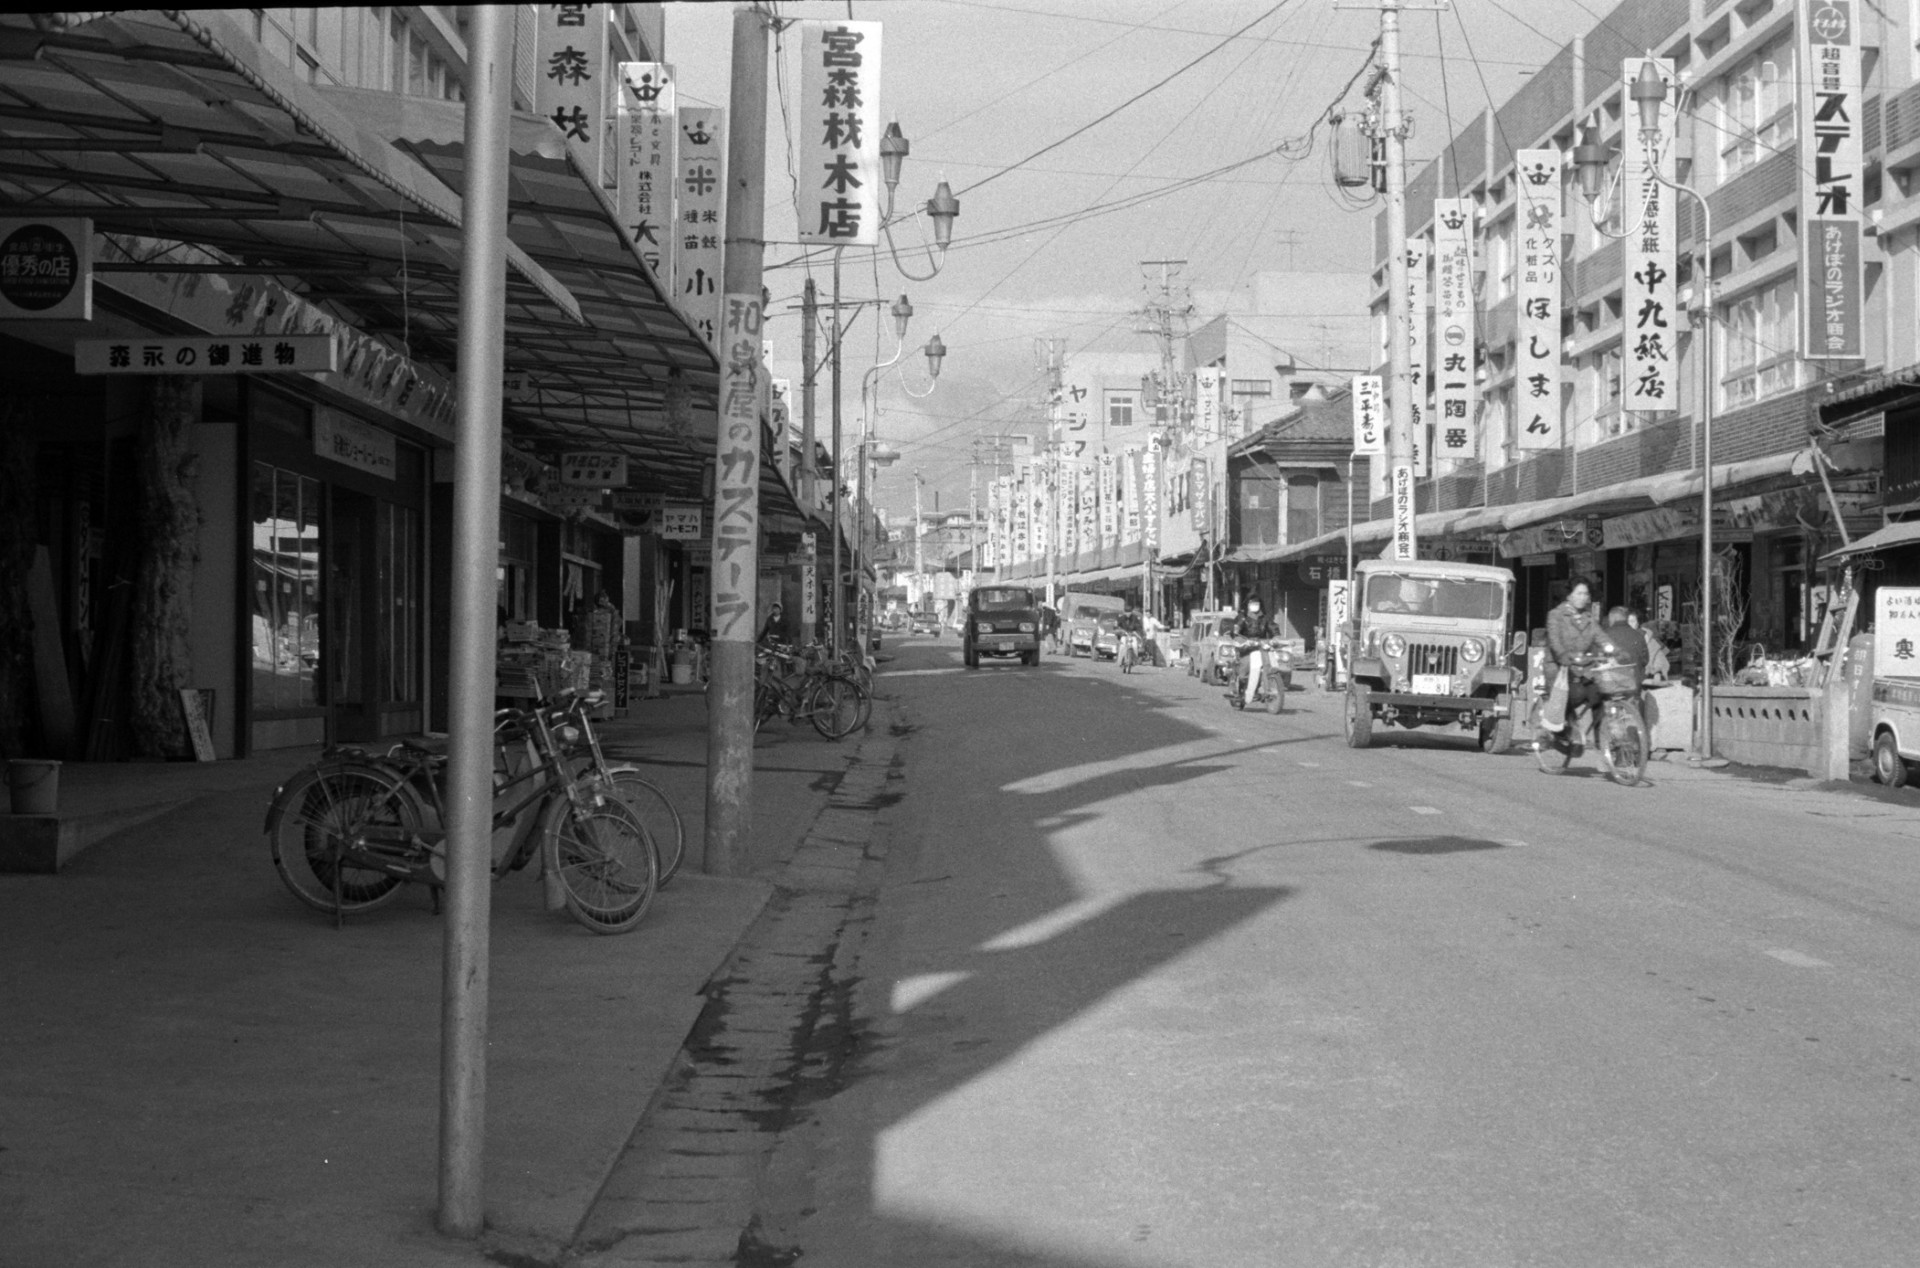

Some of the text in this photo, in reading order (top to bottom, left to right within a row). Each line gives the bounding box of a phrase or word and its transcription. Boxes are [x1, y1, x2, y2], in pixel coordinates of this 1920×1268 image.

[1813, 92, 1852, 215] ステレオ
[638, 170, 653, 215] 株式会社
[684, 209, 699, 250] 種苗
[1, 254, 71, 277] 優秀の店
[1525, 238, 1538, 283] 化粧品
[1542, 238, 1555, 284] クスリ
[1825, 225, 1845, 350] あけぼのラジオ商会
[109, 343, 296, 368] 森永の御進物
[1526, 298, 1551, 435] ほしまん
[1444, 353, 1467, 448] 丸一陶器
[665, 514, 700, 523] ヤマハ
[665, 524, 699, 533] ハーモニカ
[1894, 638, 1915, 660] 寒
